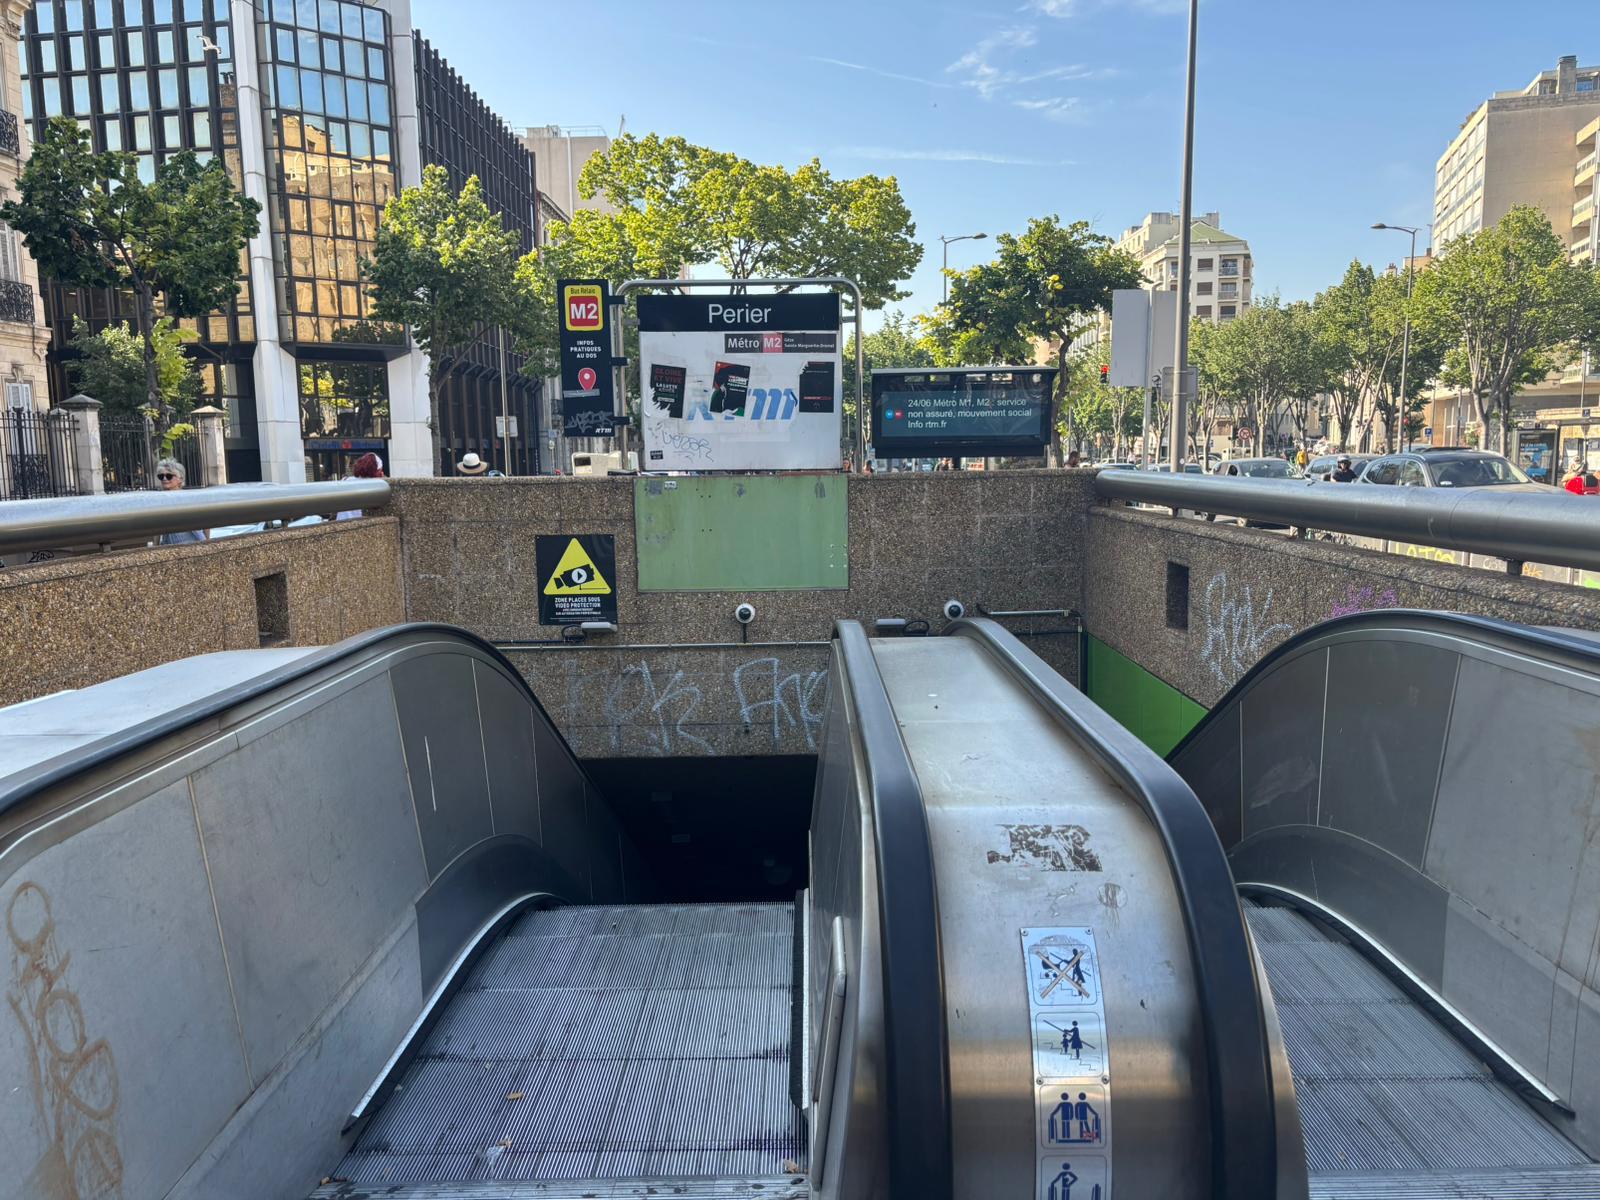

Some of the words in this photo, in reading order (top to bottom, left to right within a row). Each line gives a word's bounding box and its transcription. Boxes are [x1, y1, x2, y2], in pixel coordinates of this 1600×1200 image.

[571, 303, 598, 320] M2
[708, 303, 772, 324] Perier
[727, 337, 760, 348] Métro
[763, 338, 782, 348] M2
[908, 399, 932, 407] 24/06
[933, 398, 957, 407] Métro
[997, 398, 1027, 406] service
[908, 410, 924, 418] non
[957, 408, 1006, 417] mouvement
[1008, 408, 1032, 417] social
[907, 420, 924, 429] Info
[925, 420, 947, 429] rtm.fr
